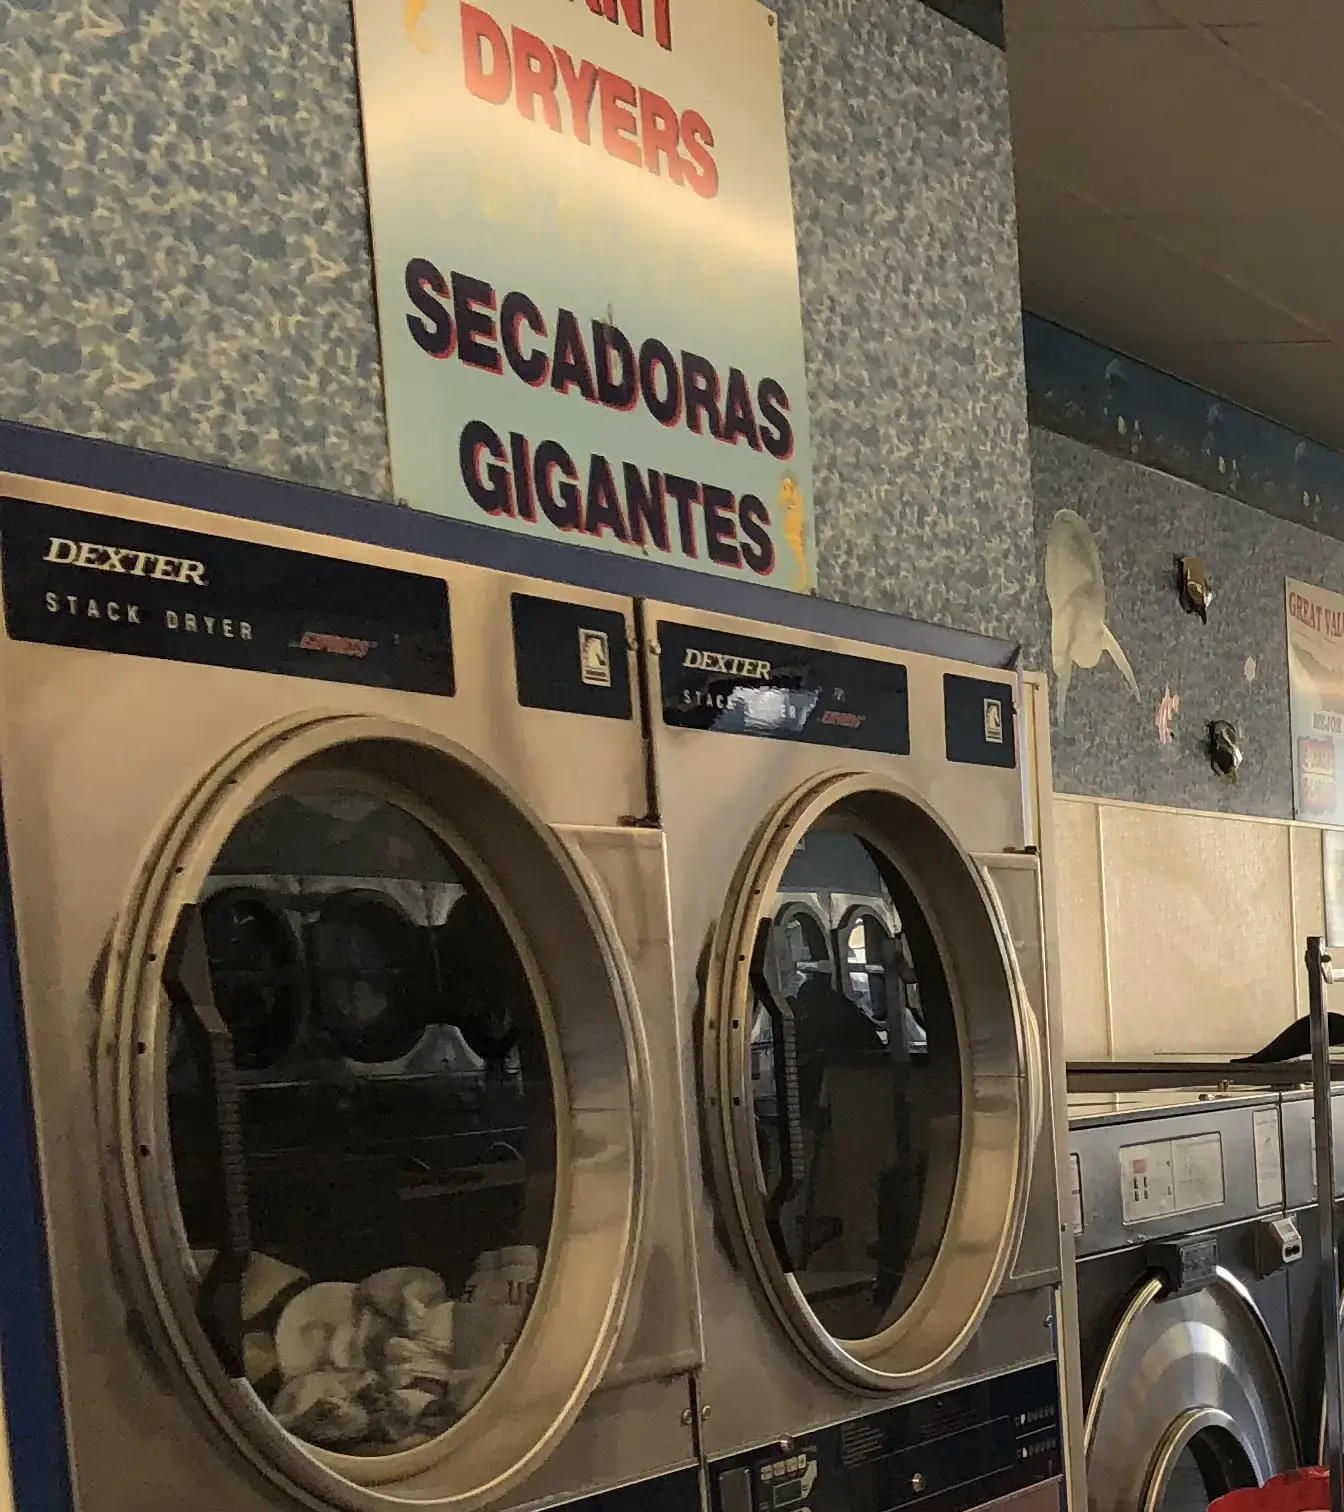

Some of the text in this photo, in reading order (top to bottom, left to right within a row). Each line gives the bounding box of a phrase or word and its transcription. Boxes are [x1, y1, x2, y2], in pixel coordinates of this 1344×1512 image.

[459, 0, 719, 200] DRYERS
[405, 257, 794, 461] SECADORAS
[459, 420, 775, 576] GIGANTES
[43, 537, 209, 587] DEXTER
[44, 591, 253, 641] STACK DRYER
[1288, 591, 1322, 632] GREAT
[682, 648, 771, 680] DEXTER
[1313, 712, 1342, 734] MEJOR
